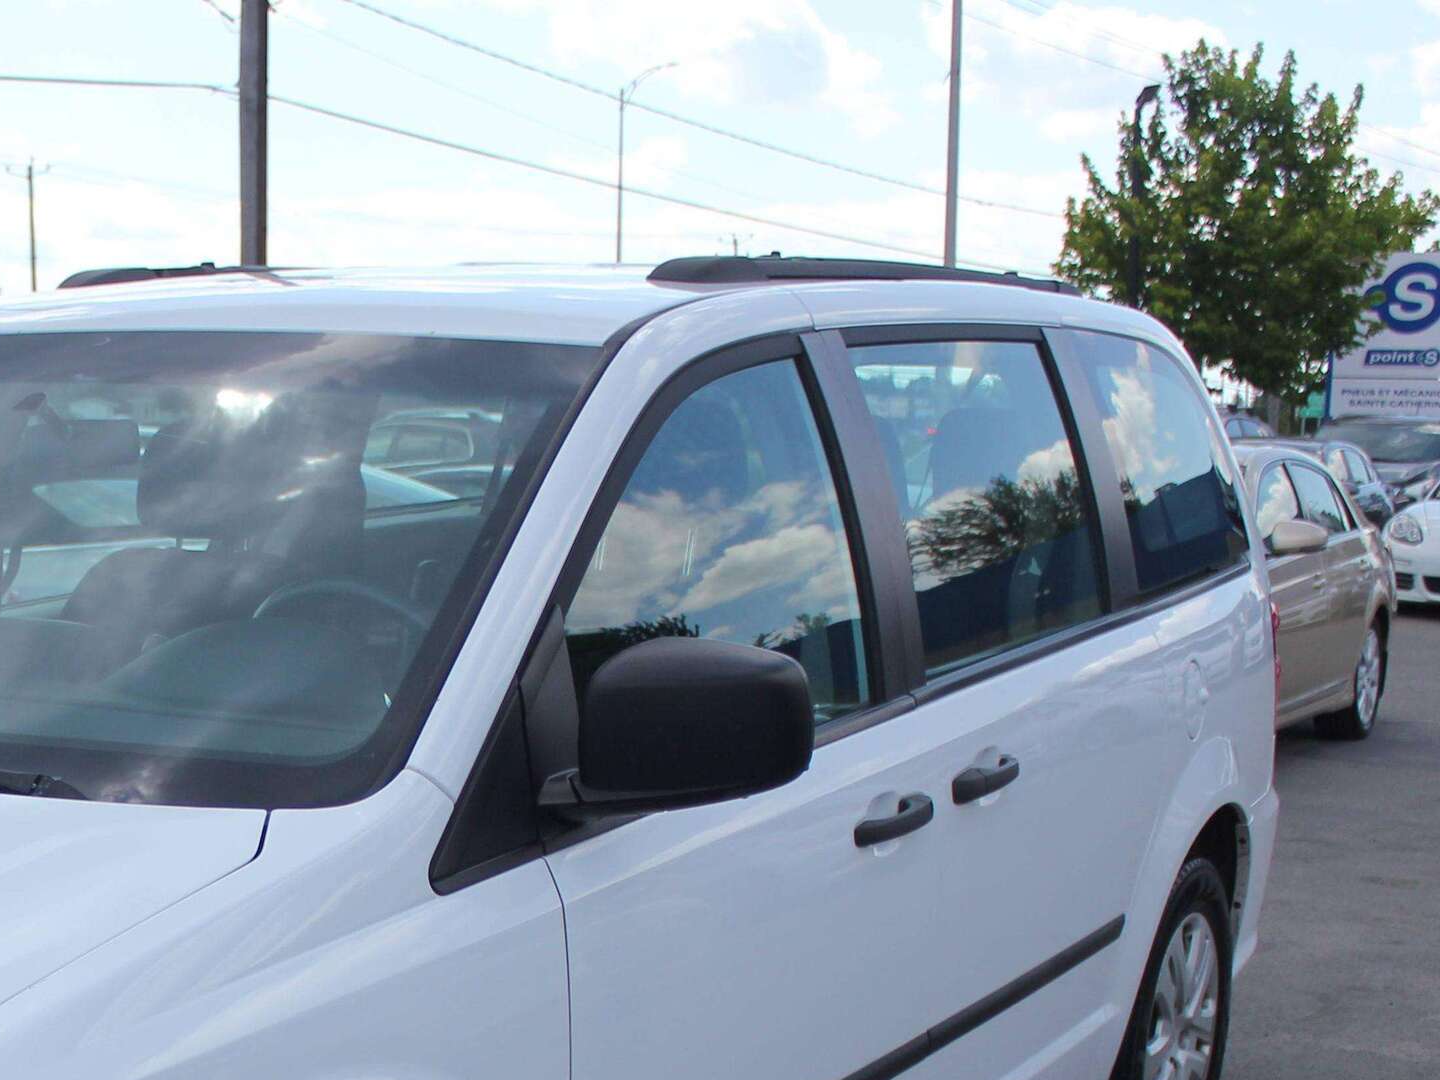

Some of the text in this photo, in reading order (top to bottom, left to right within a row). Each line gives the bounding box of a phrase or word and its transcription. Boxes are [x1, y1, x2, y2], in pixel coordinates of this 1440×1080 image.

[1388, 273, 1438, 322] S
[1341, 388, 1376, 396] PNEUS
[1378, 388, 1390, 396] ET
